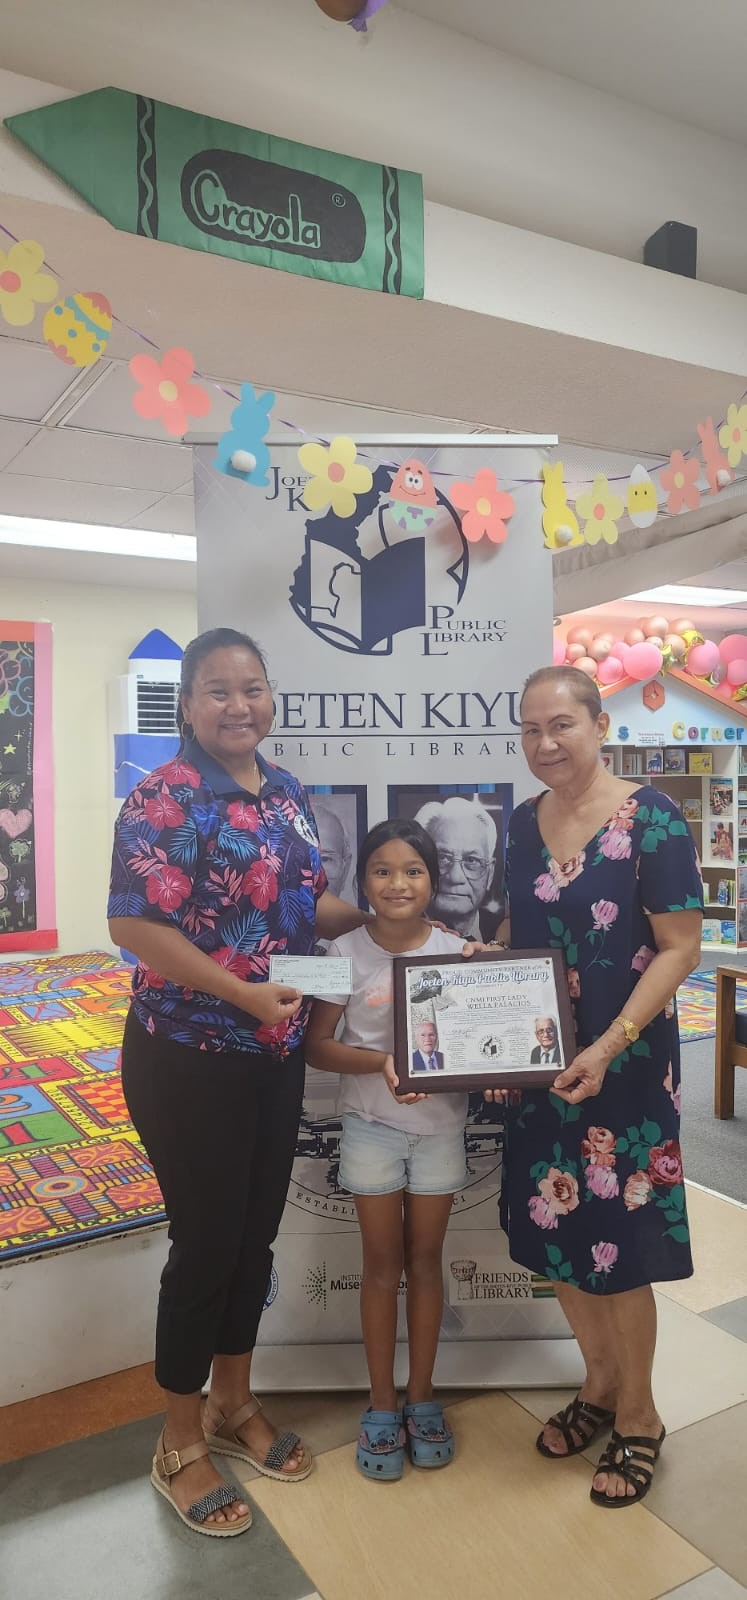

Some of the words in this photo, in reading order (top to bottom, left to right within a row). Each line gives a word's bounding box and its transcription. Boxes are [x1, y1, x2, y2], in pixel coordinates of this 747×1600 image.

[190, 169, 321, 249] Crayola
[672, 721, 745, 742] Corner
[274, 742, 354, 756] BLIC
[385, 741, 517, 757] LIBRAR
[510, 969, 550, 984] Library
[296, 1192, 355, 1216] ESTABLI
[330, 1280, 361, 1291] Muse
[474, 1272, 529, 1284] FRIENDS
[474, 1287, 530, 1300] LIBRARY
